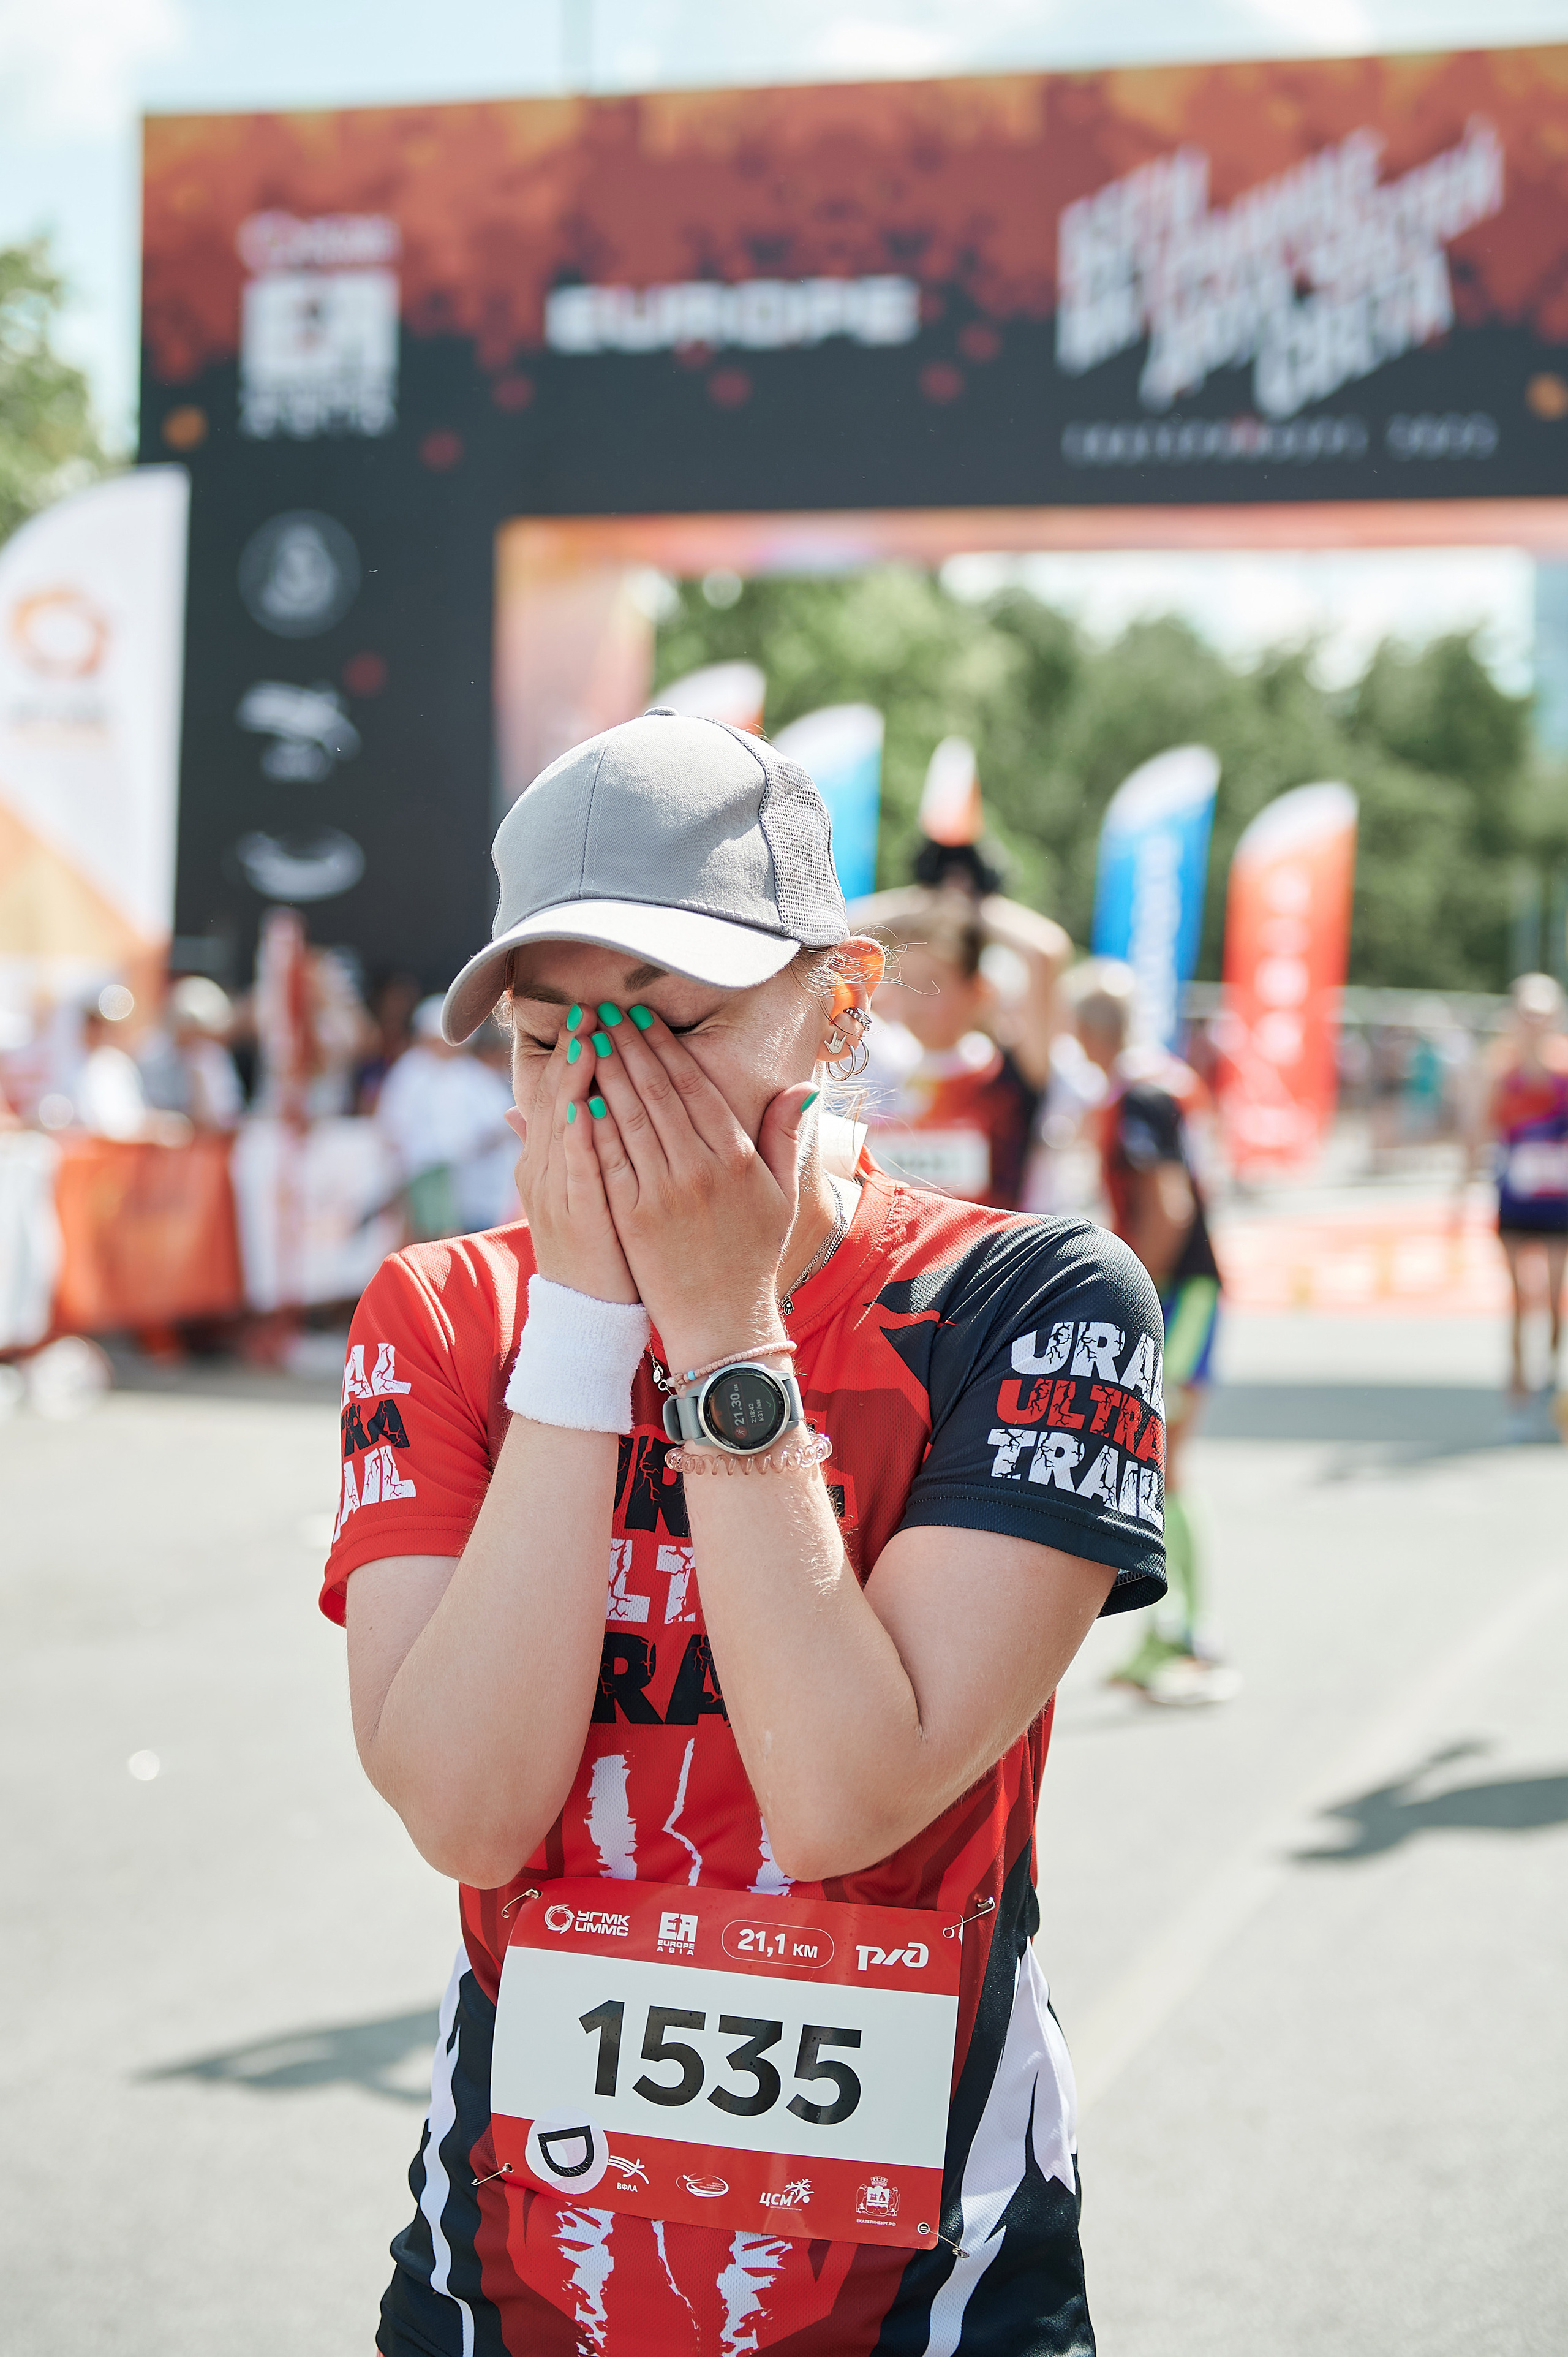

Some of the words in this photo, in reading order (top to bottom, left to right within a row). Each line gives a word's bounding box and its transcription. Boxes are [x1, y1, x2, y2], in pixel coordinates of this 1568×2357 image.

[730, 1393, 745, 1426] 21.30
[748, 1403, 757, 1424] 2:18:42
[996, 1377, 1165, 1473] ULTRA
[987, 1428, 1165, 1532] TRAIL
[575, 1921, 629, 1937] UMMC
[576, 1910, 631, 1926] УГМК
[657, 1939, 695, 1950] EUROPE
[737, 1928, 786, 1958] 21,1
[578, 2000, 862, 2125] 1535
[537, 2125, 595, 2177] D
[617, 2182, 638, 2192] ВФЛА
[760, 2192, 793, 2207] ЦСМ
